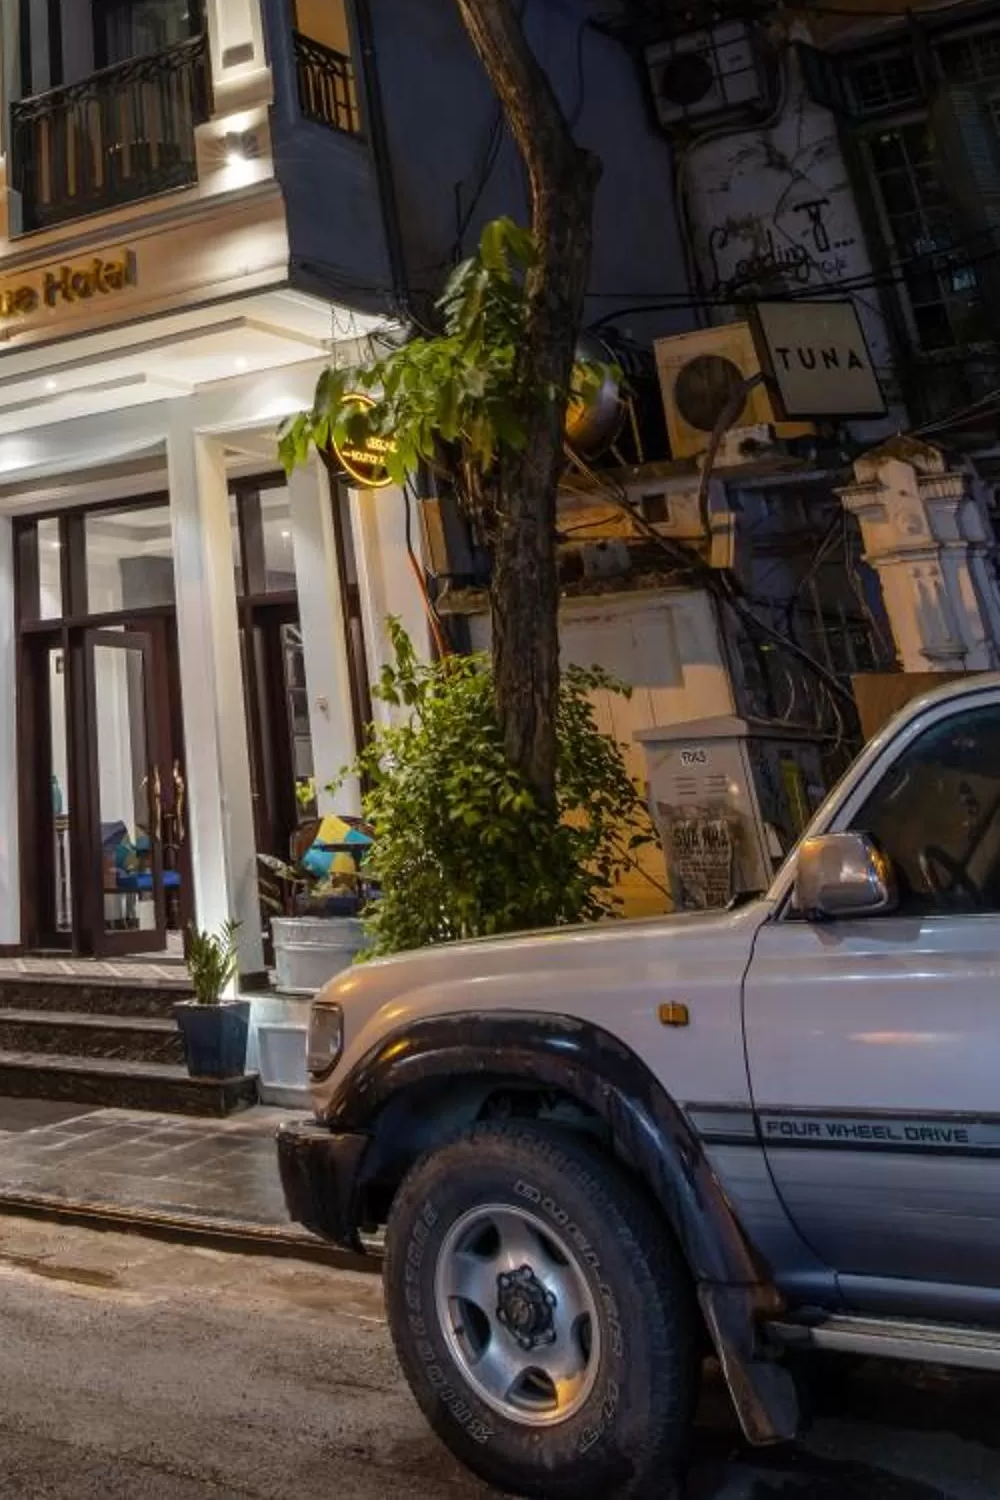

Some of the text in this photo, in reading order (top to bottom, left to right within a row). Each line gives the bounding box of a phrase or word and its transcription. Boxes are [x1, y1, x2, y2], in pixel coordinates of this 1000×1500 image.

[43, 248, 136, 308] Hotel
[775, 346, 865, 371] TUNA
[766, 1120, 970, 1144] FOUR WHEEL DRIVE
